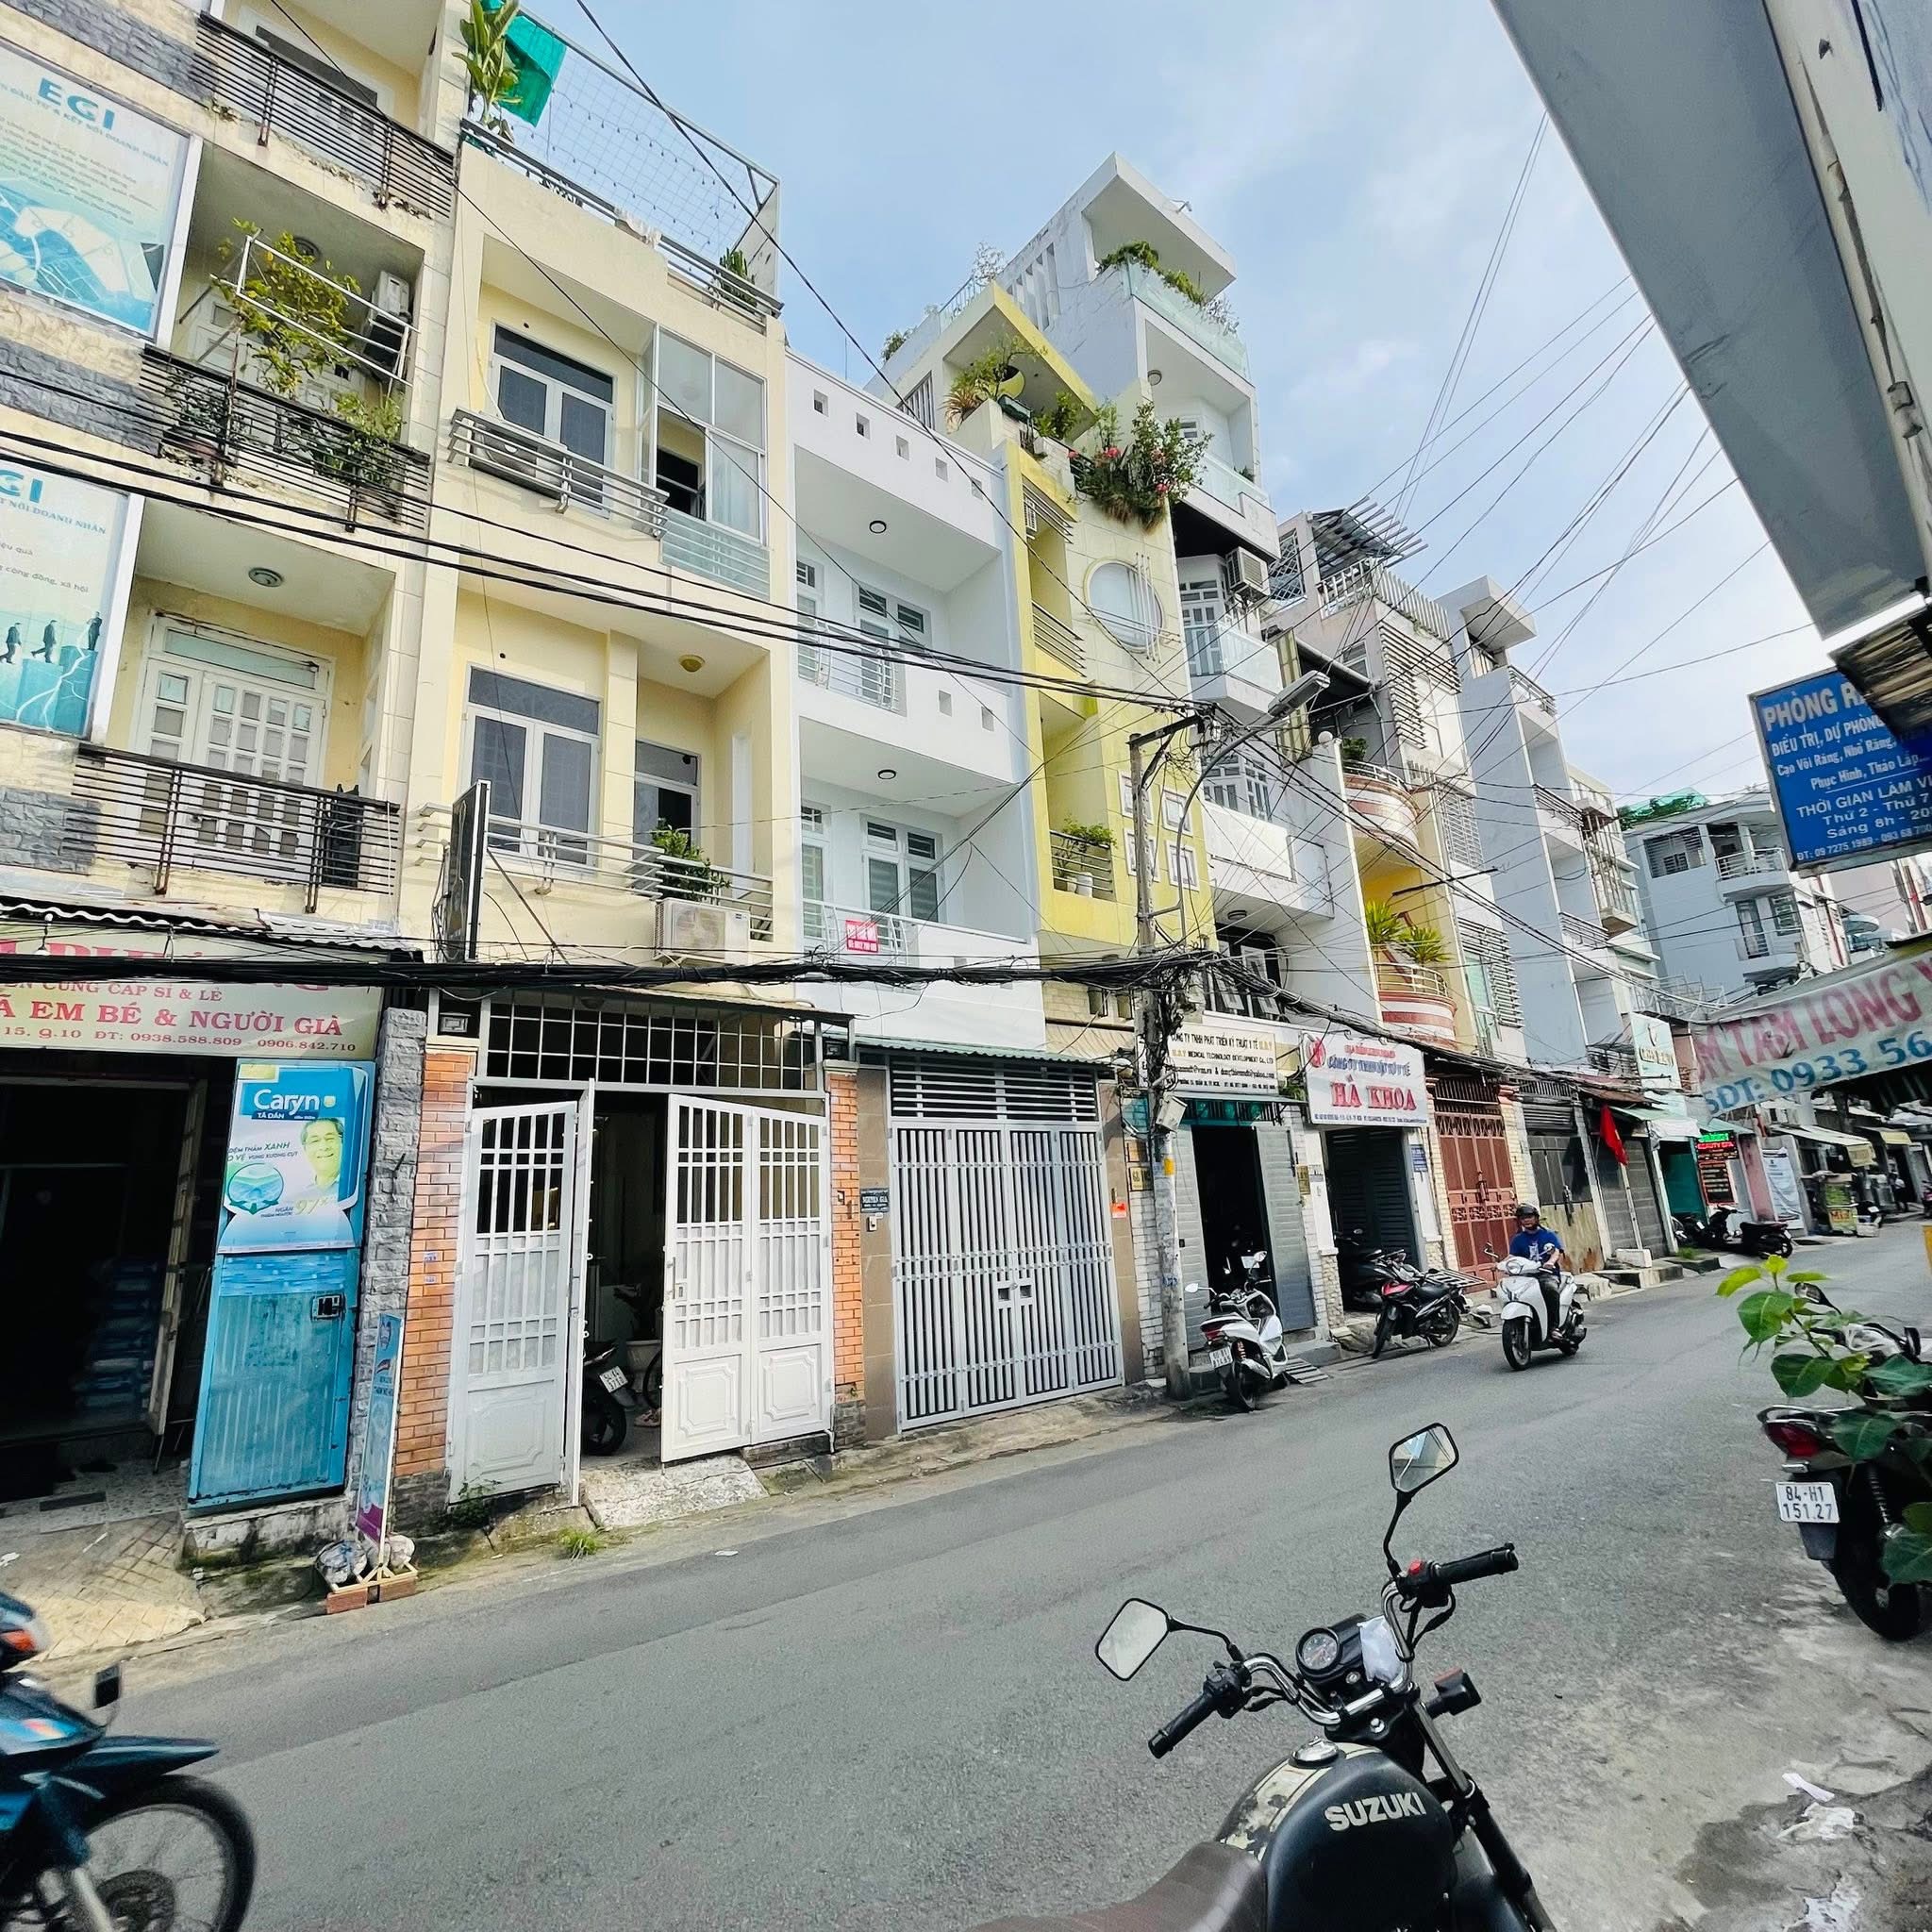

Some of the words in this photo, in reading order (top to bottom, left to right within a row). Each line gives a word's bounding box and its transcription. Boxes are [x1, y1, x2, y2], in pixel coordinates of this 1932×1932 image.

[39, 77, 115, 130] EGI
[32, 508, 74, 525] DOANH
[1762, 688, 1839, 731] PHÒNG
[1772, 733, 1798, 757] ĐIỀU
[1824, 722, 1841, 743] DỰ
[1810, 774, 1838, 791] Phục
[1796, 798, 1832, 818] THỜI
[1836, 790, 1874, 808] GIAN
[1877, 780, 1913, 799] LÀM
[1858, 808, 1869, 817] 2
[1920, 792, 1929, 803] 7
[1827, 824, 1869, 839] Sáng
[1874, 817, 1895, 828] 8h
[179, 989, 192, 1000] &
[1800, 969, 1923, 1045] LONG
[29, 1001, 86, 1022] EM
[96, 1001, 142, 1025] BÉ
[154, 1008, 177, 1027] &
[189, 1010, 285, 1033] NGƯỜI
[294, 1015, 342, 1037] GIÀ
[131, 1032, 242, 1046] 0938.588.809
[258, 1039, 356, 1052] 0906.842.710
[1771, 1048, 1868, 1092] 0933
[254, 1089, 320, 1116] Caryn
[1366, 1085, 1417, 1110] KHOA
[264, 1141, 291, 1152] XANH
[1324, 1792, 1427, 1832] SUZUKI
